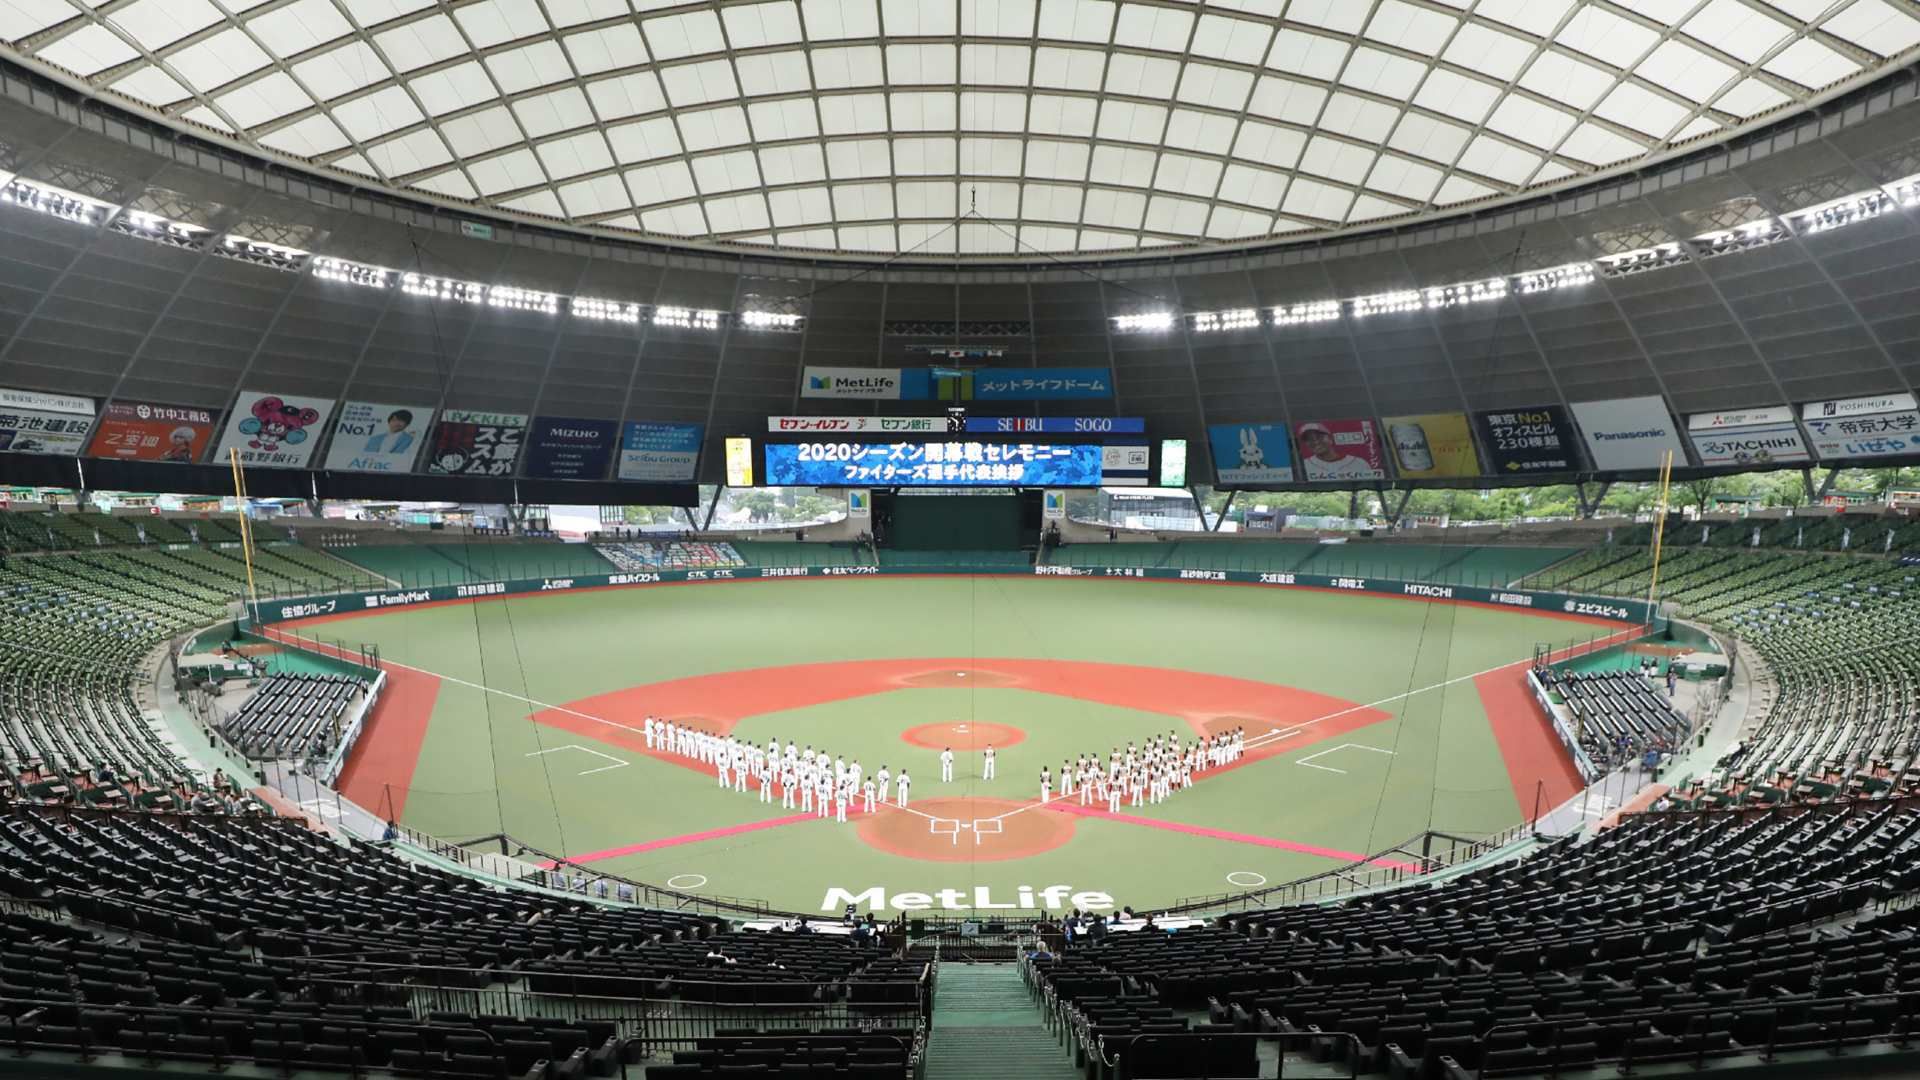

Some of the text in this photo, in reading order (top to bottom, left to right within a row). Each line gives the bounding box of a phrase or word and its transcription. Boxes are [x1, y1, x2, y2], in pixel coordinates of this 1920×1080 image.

[835, 378, 894, 388] MetLife
[982, 380, 1105, 391] メットライフドーム
[1840, 399, 1895, 410] YOSHIMURA
[153, 407, 210, 422] 竹中工務店
[1488, 411, 1552, 426] 東京 No.1
[339, 422, 375, 436] No.1
[881, 418, 931, 430] セブン銀行
[998, 418, 1043, 431] SEIBU
[1074, 418, 1112, 431] SOGO
[1837, 415, 1919, 434] 帝京大学
[550, 428, 599, 438] MIZUHO
[1493, 424, 1556, 437] オフィスビル
[1594, 428, 1666, 440] Panasonic
[1497, 435, 1560, 450] 230棟超
[1723, 438, 1797, 450] TACHIHI
[798, 442, 1072, 462] 2020シーズン開幕戦セレモニー
[348, 457, 392, 469] Aflac
[845, 464, 1025, 481] ファイターズ選手代表挨拶
[687, 570, 707, 578] CTC
[713, 569, 733, 577] CTC
[761, 567, 808, 577] 三井住友銀行
[1035, 566, 1093, 576] 野村不動産グループ
[1260, 573, 1296, 584] 大成建設
[1338, 578, 1365, 589] 関電工
[1404, 584, 1453, 598] HITACHI
[380, 590, 430, 605] FamilyMart
[281, 599, 337, 618] 住協グループ
[820, 884, 1115, 912] MetLife
